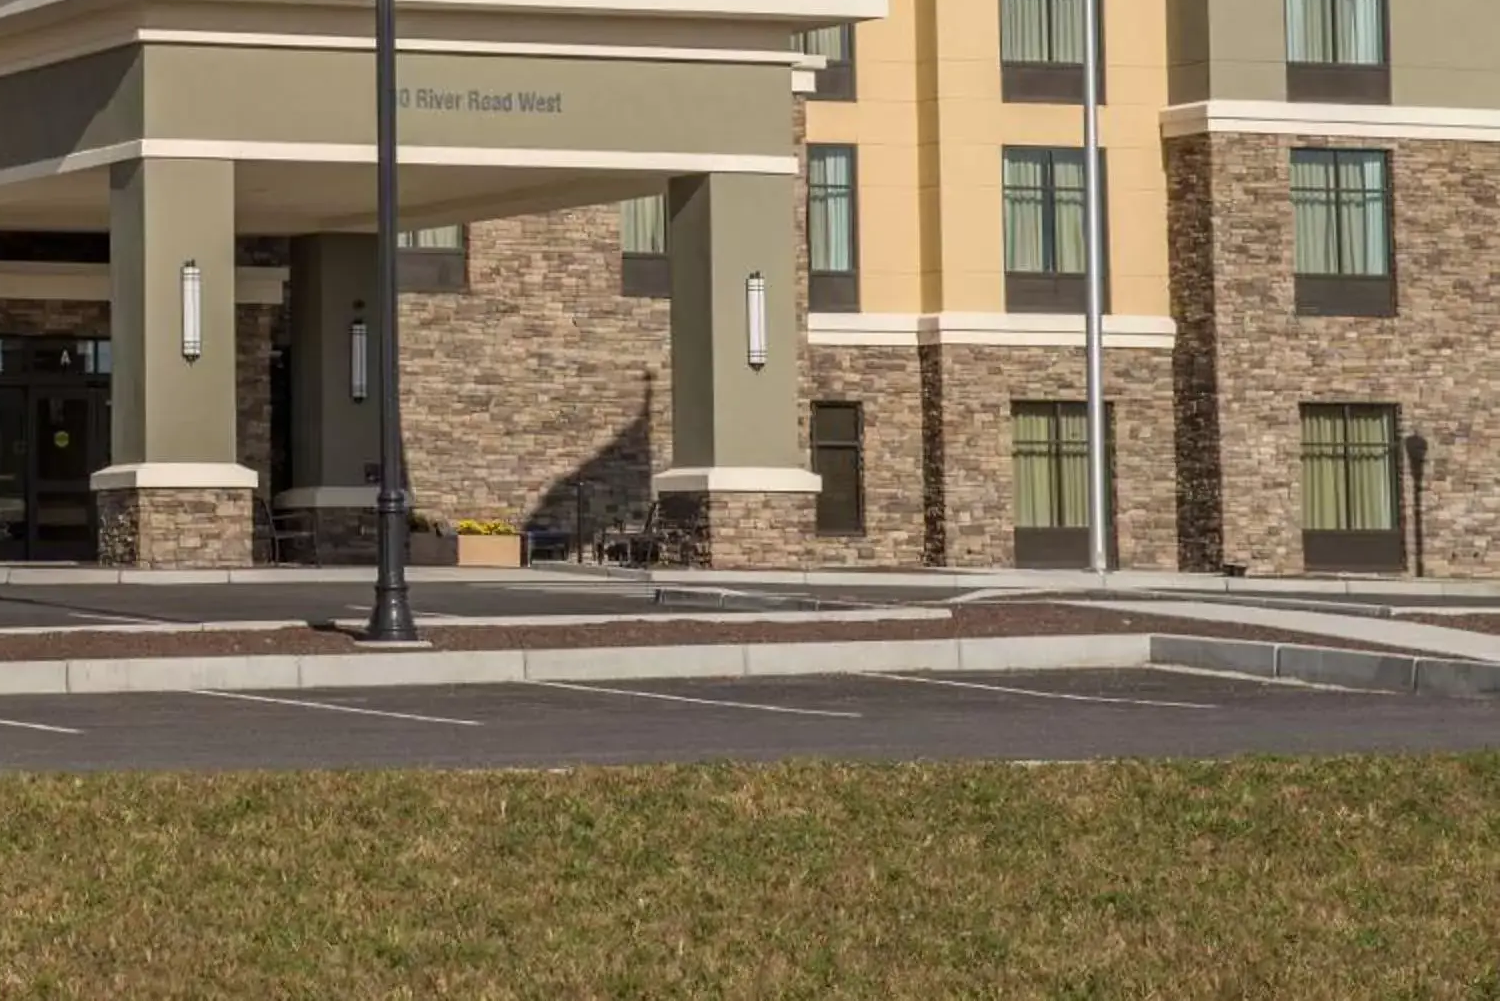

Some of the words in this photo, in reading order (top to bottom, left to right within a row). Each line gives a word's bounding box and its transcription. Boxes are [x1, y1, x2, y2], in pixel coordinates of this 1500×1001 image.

[415, 88, 461, 111] River
[467, 90, 512, 112] Road
[518, 91, 563, 114] West
